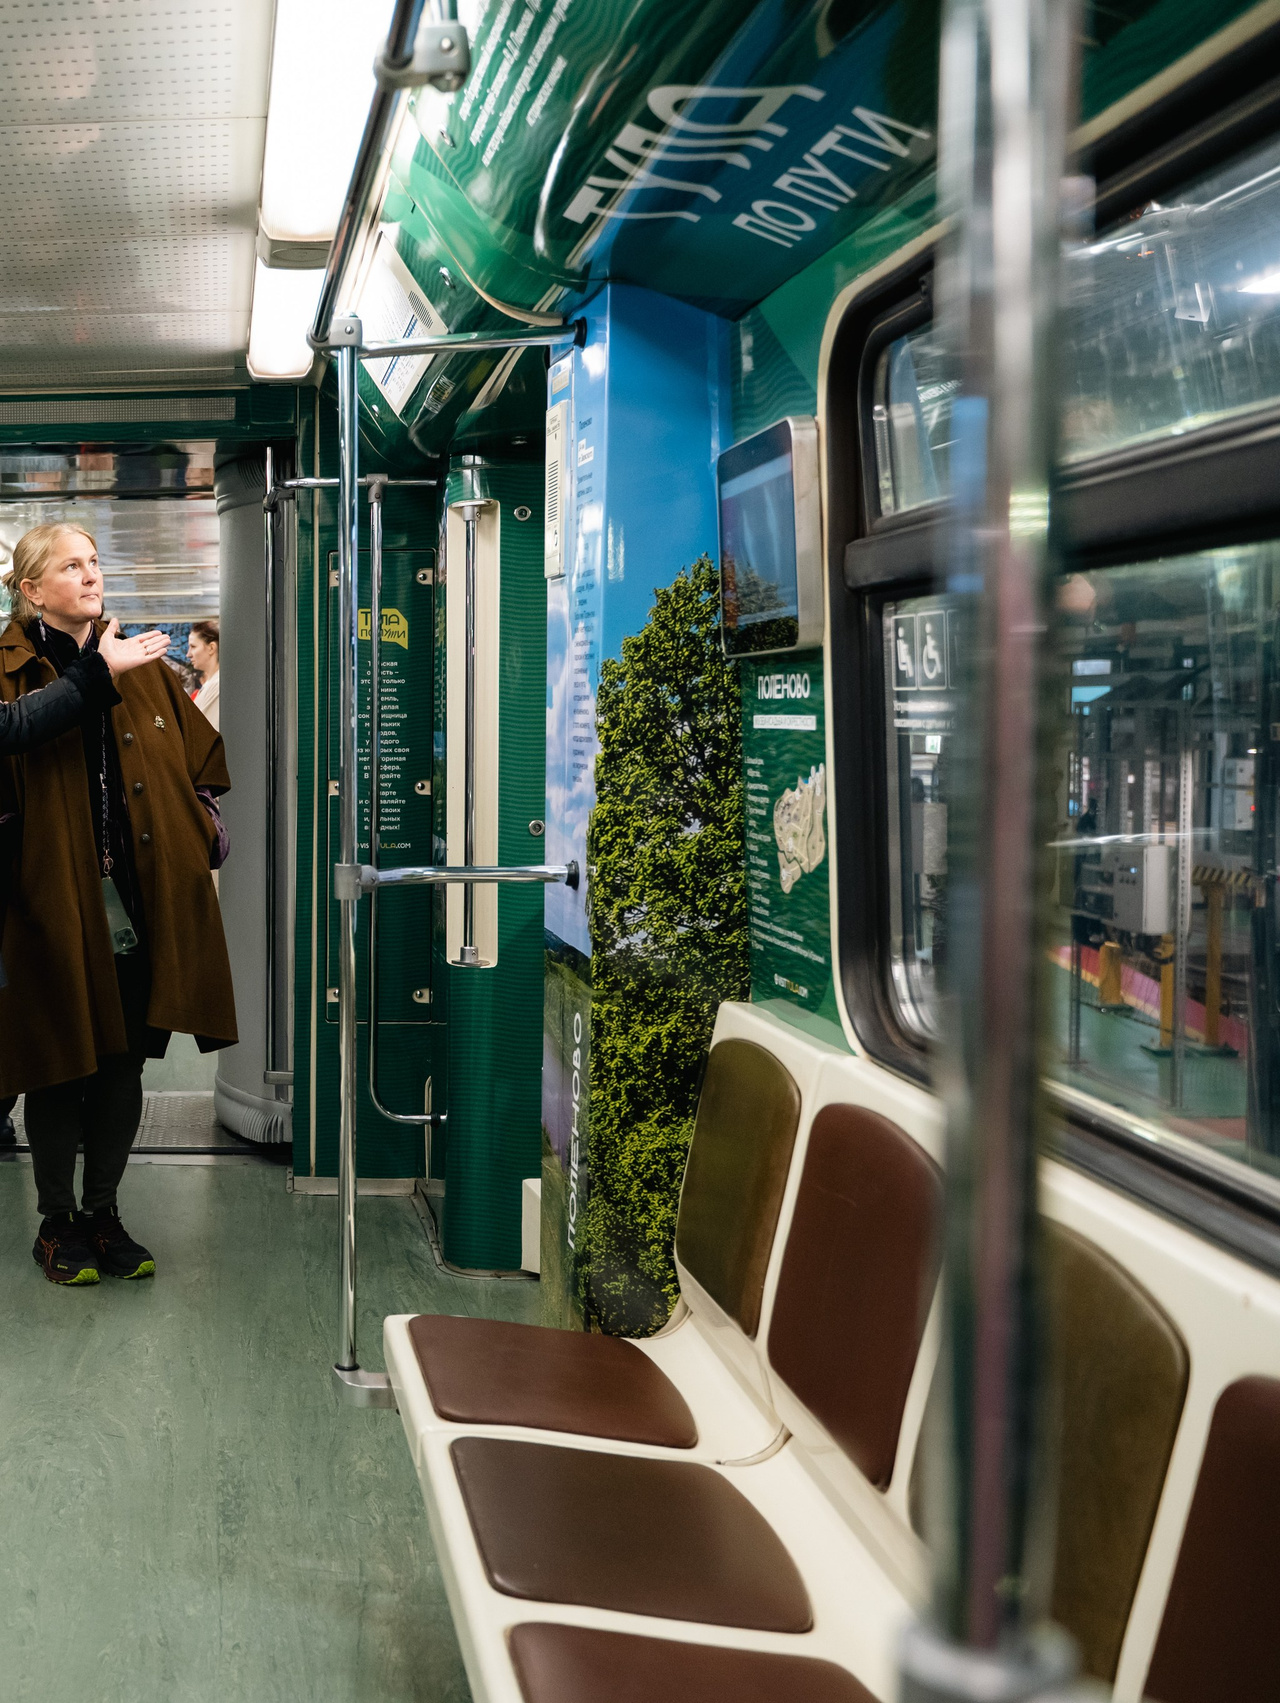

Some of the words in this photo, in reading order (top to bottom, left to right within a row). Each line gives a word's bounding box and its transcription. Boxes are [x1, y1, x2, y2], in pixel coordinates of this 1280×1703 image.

[562, 84, 826, 225] ТУЛА
[772, 105, 931, 212] ПУТИ
[731, 199, 817, 248] ПО
[361, 611, 400, 626] ТЛА
[757, 673, 810, 700] ПОЛЕНОВО
[567, 1012, 582, 1250] ПОЛЕНОВО
